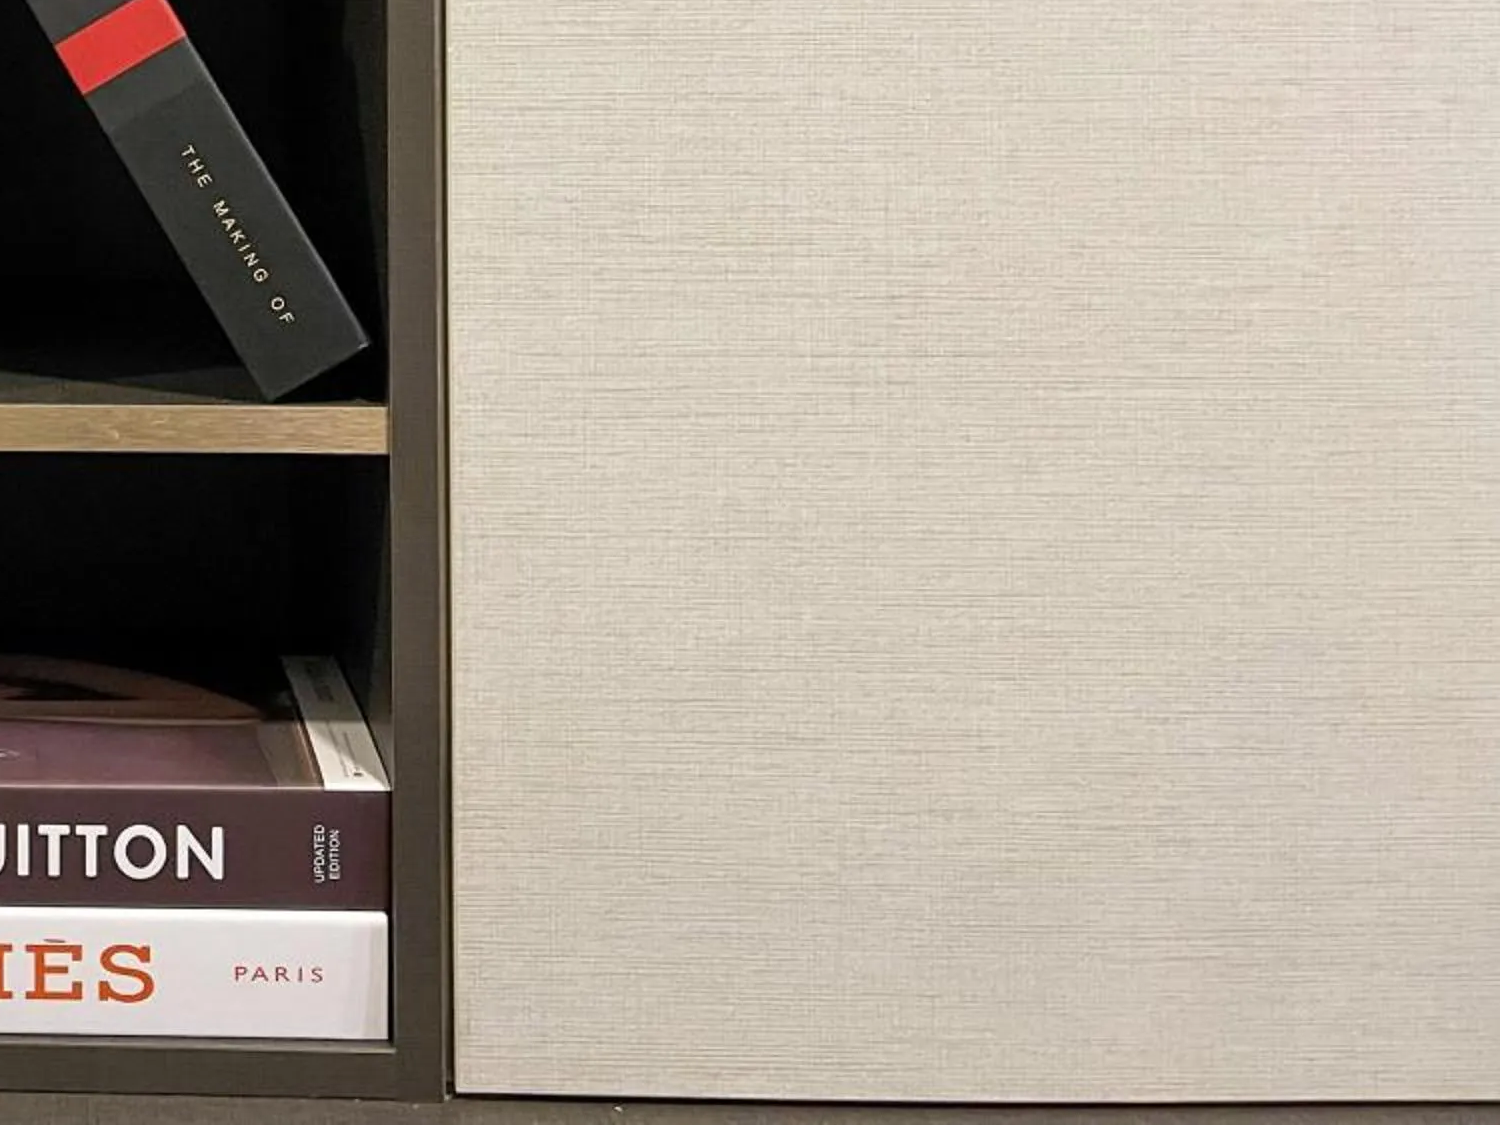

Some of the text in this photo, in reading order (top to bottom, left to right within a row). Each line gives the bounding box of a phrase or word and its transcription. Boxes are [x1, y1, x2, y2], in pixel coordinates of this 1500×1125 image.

[180, 143, 296, 326] THE MAKING OF
[312, 823, 327, 884] UPDATED
[328, 828, 342, 881] EDITION
[234, 965, 324, 984] PARIS
